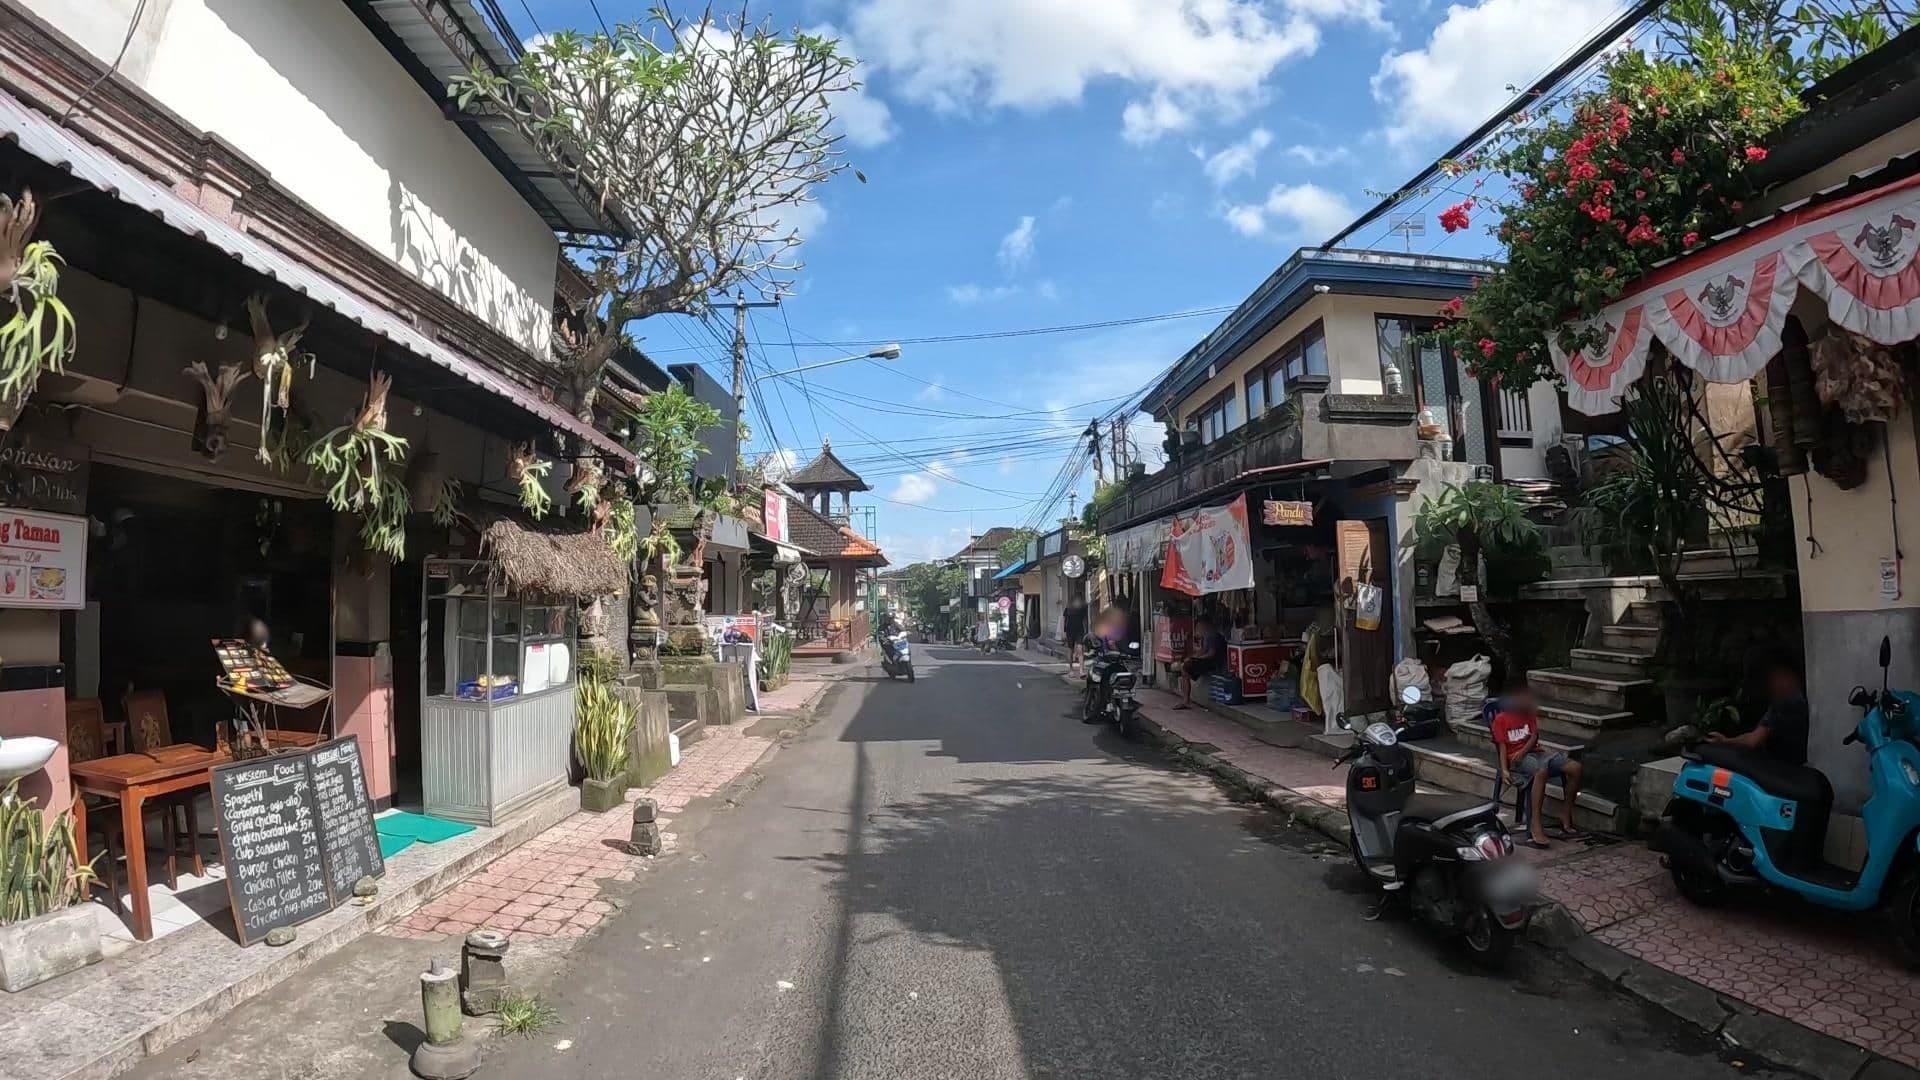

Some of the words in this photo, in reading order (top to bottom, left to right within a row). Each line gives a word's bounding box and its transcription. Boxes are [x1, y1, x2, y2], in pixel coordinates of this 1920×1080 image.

[14, 518, 60, 544] Taman
[273, 762, 295, 777] Food
[239, 860, 269, 880] Burger
[303, 846, 319, 860] 25K
[304, 862, 321, 880] 35K
[307, 879, 324, 893] 20K
